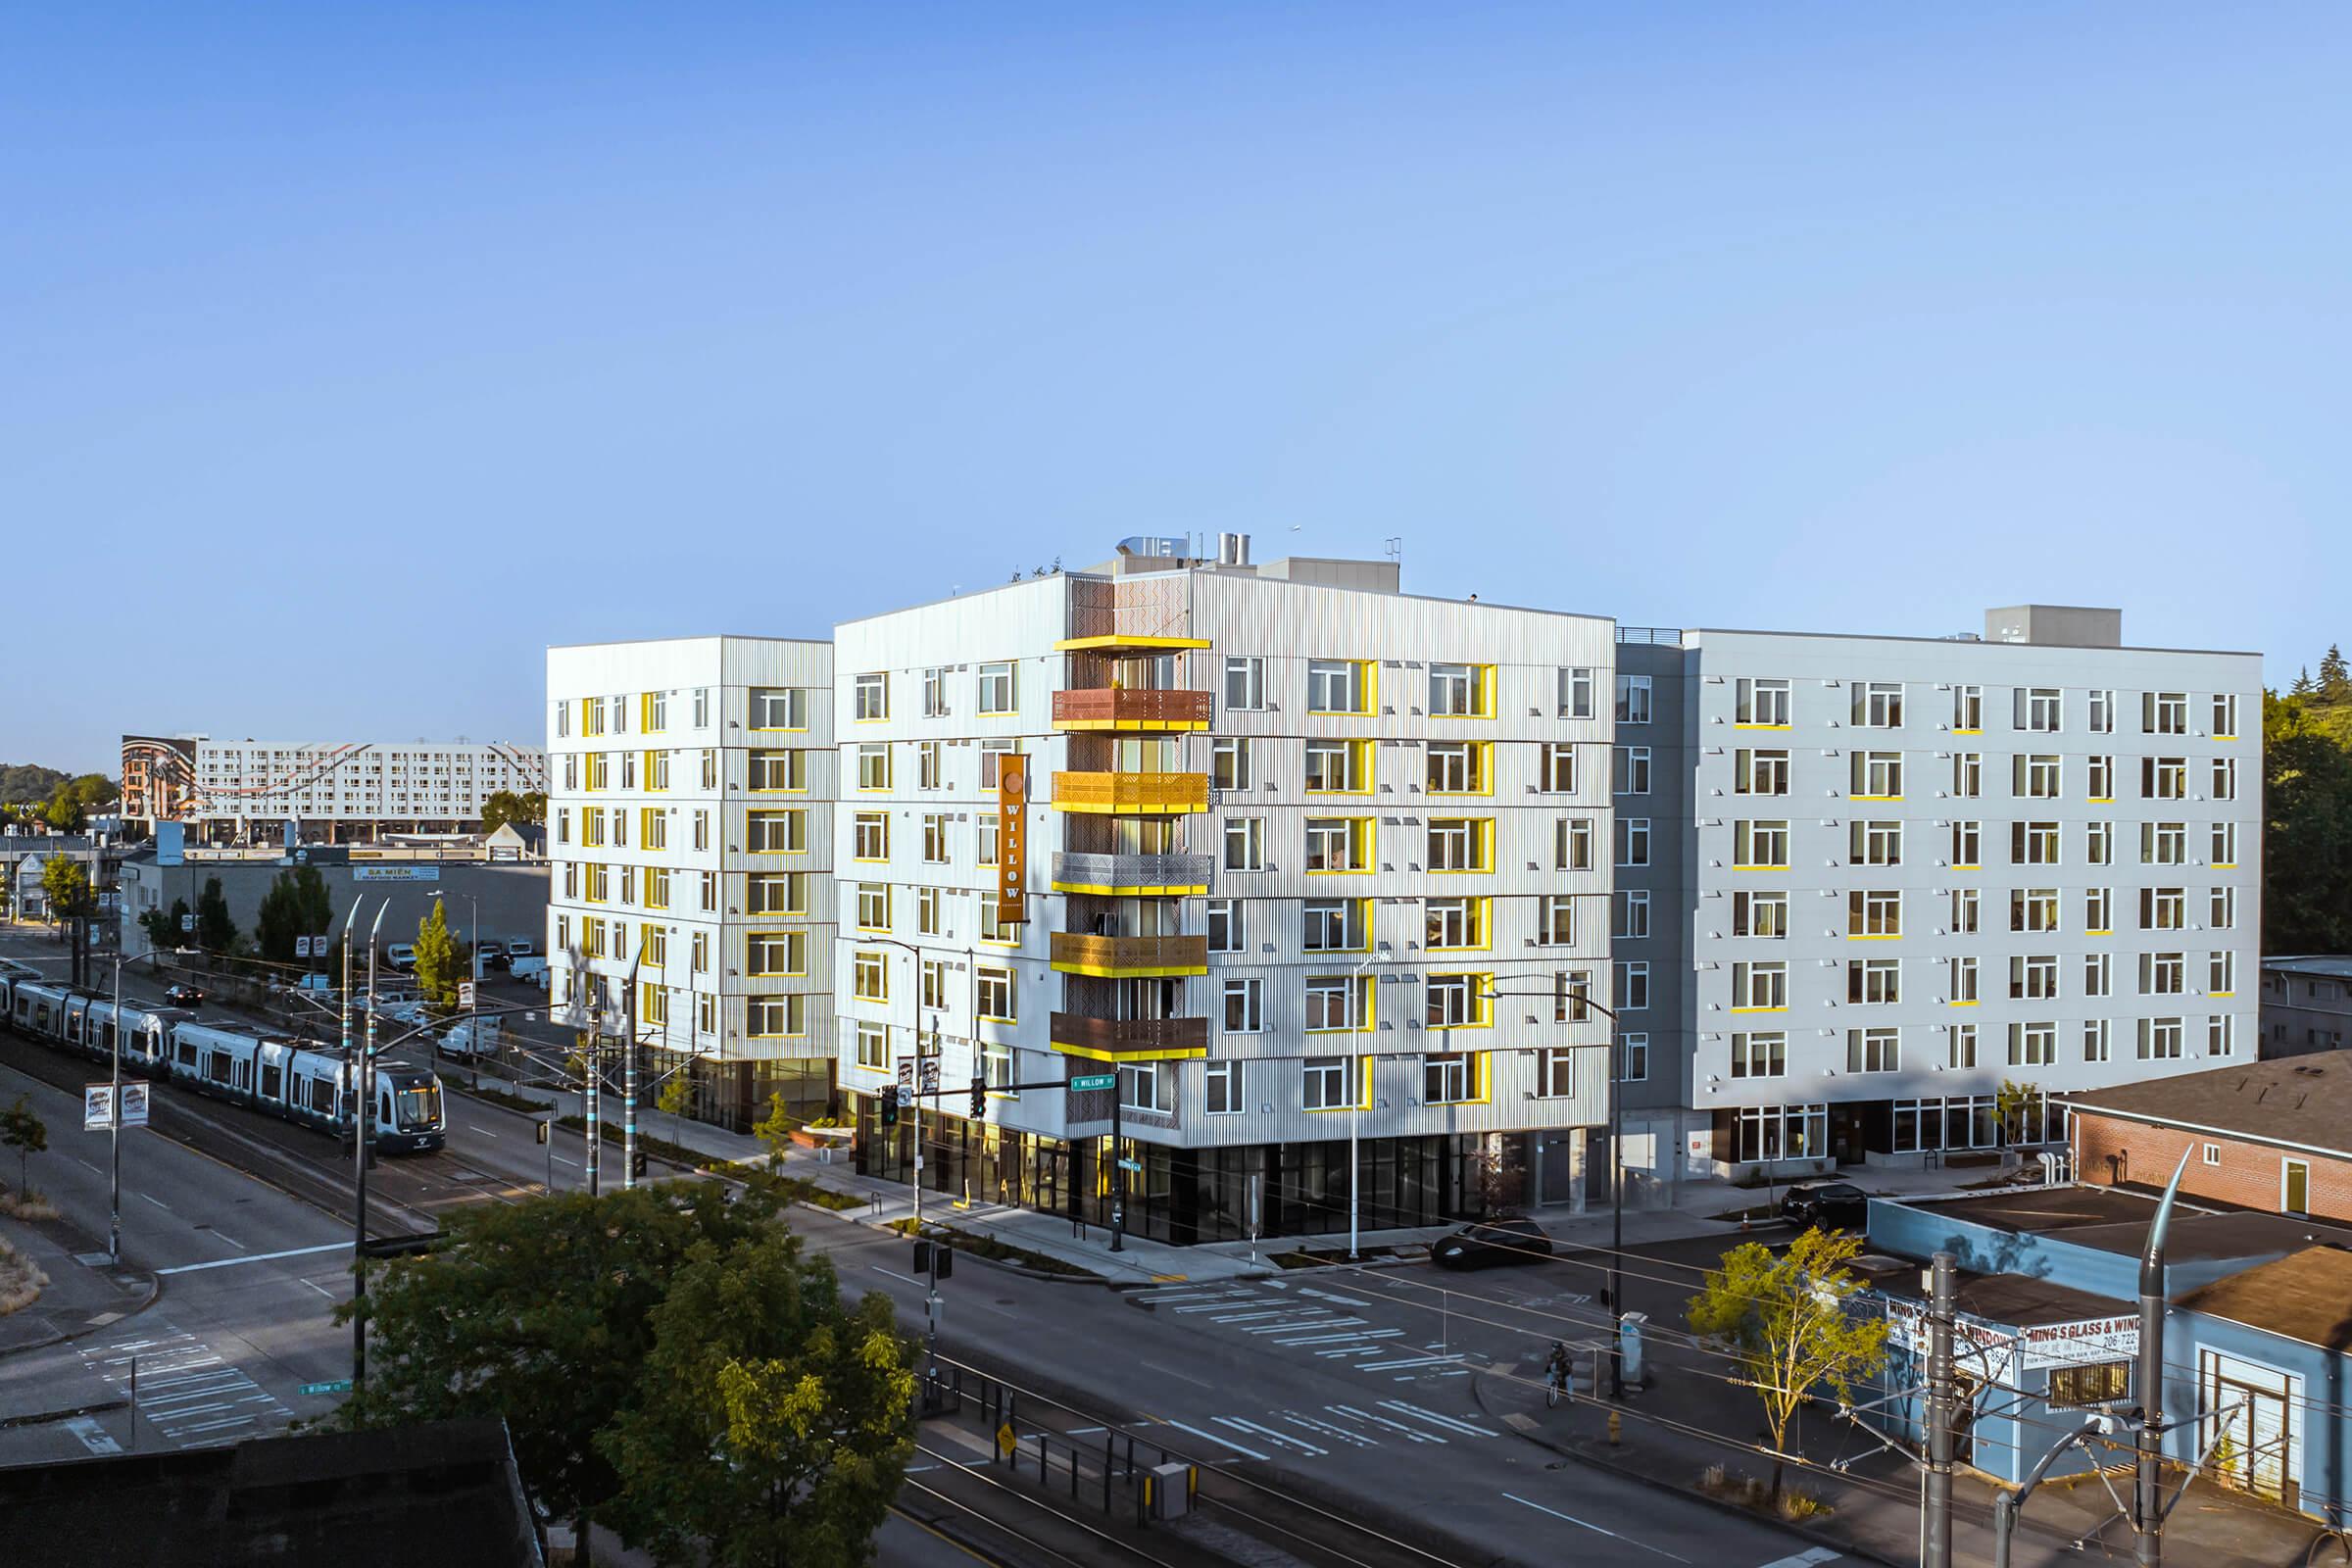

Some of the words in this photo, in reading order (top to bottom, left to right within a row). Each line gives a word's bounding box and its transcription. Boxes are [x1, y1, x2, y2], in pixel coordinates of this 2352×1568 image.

[1005, 805, 1020, 899] WILLOW
[1081, 1078, 1104, 1087] WILLOW
[2029, 1325, 2067, 1343] MING'S
[2069, 1321, 2102, 1338] GLASS
[2104, 1320, 2112, 1334] &
